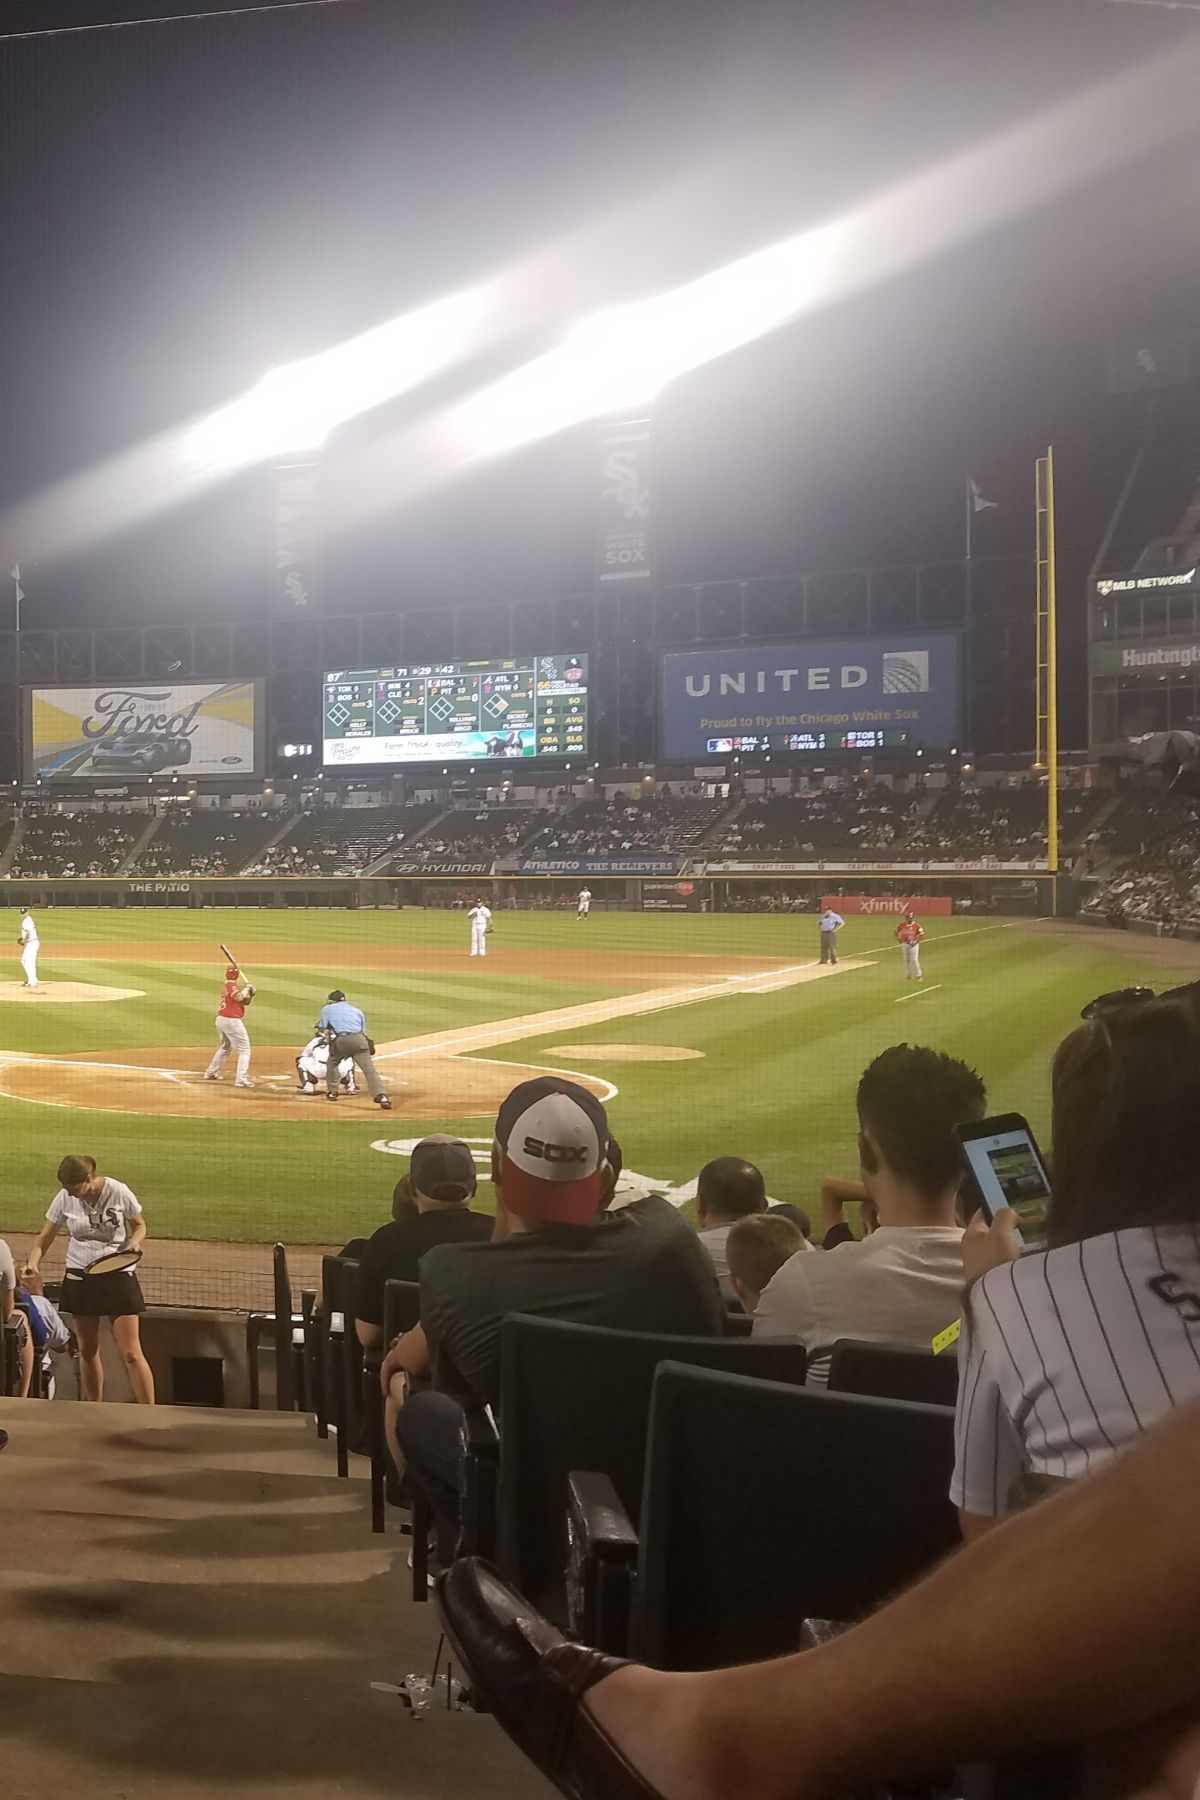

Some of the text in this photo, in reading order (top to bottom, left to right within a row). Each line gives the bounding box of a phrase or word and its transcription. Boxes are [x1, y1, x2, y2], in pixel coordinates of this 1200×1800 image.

[606, 548, 645, 565] SOX
[1113, 572, 1193, 591] MLB NETWORK
[397, 665, 454, 677] 71 29 42
[338, 685, 352, 693] TOR
[494, 675, 509, 683] ATL
[537, 681, 551, 690] 66
[685, 665, 868, 698] UNITED
[494, 684, 511, 692] NYM
[366, 700, 373, 708] 3
[417, 697, 424, 705] 2
[527, 690, 533, 699] 1
[568, 697, 581, 705] SO
[81, 690, 202, 738] Ford
[565, 716, 583, 724] AVG
[700, 709, 919, 729] Proud to fly the Chicago White Sox
[546, 726, 553, 734] 0
[566, 735, 583, 743] SLG
[421, 863, 486, 873] HYUNDAI
[523, 860, 673, 871] ATHLETICO THE RELIEVERS
[129, 883, 190, 892] THE PATIO
[860, 897, 910, 914] xfinity
[522, 1136, 589, 1164] SOX
